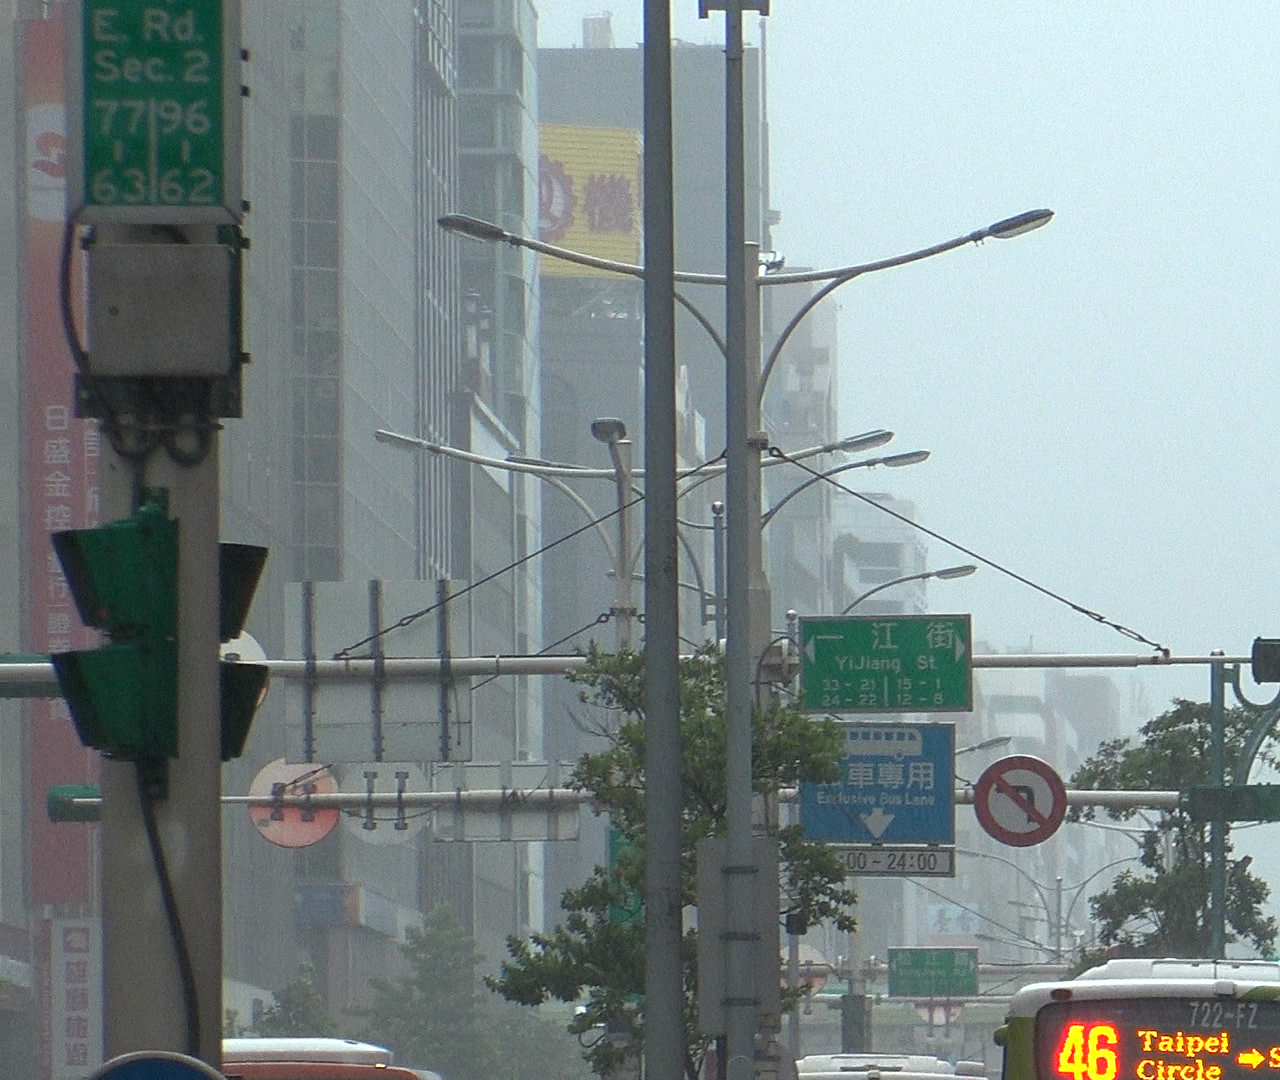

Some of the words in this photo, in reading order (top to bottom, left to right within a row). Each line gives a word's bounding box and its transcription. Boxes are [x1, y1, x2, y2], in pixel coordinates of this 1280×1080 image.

[94, 50, 173, 82] Sec.
[183, 50, 210, 82] 2
[94, 100, 145, 135] 77
[158, 99, 210, 134] 96
[92, 169, 147, 203] 63
[160, 168, 213, 203] 62
[816, 622, 953, 650] 一江街
[917, 655, 937, 670] St
[817, 762, 935, 789] 車專用
[887, 852, 937, 871] 24:00
[1188, 1001, 1258, 1029] 722-FZ
[1137, 1030, 1229, 1057] Taipei
